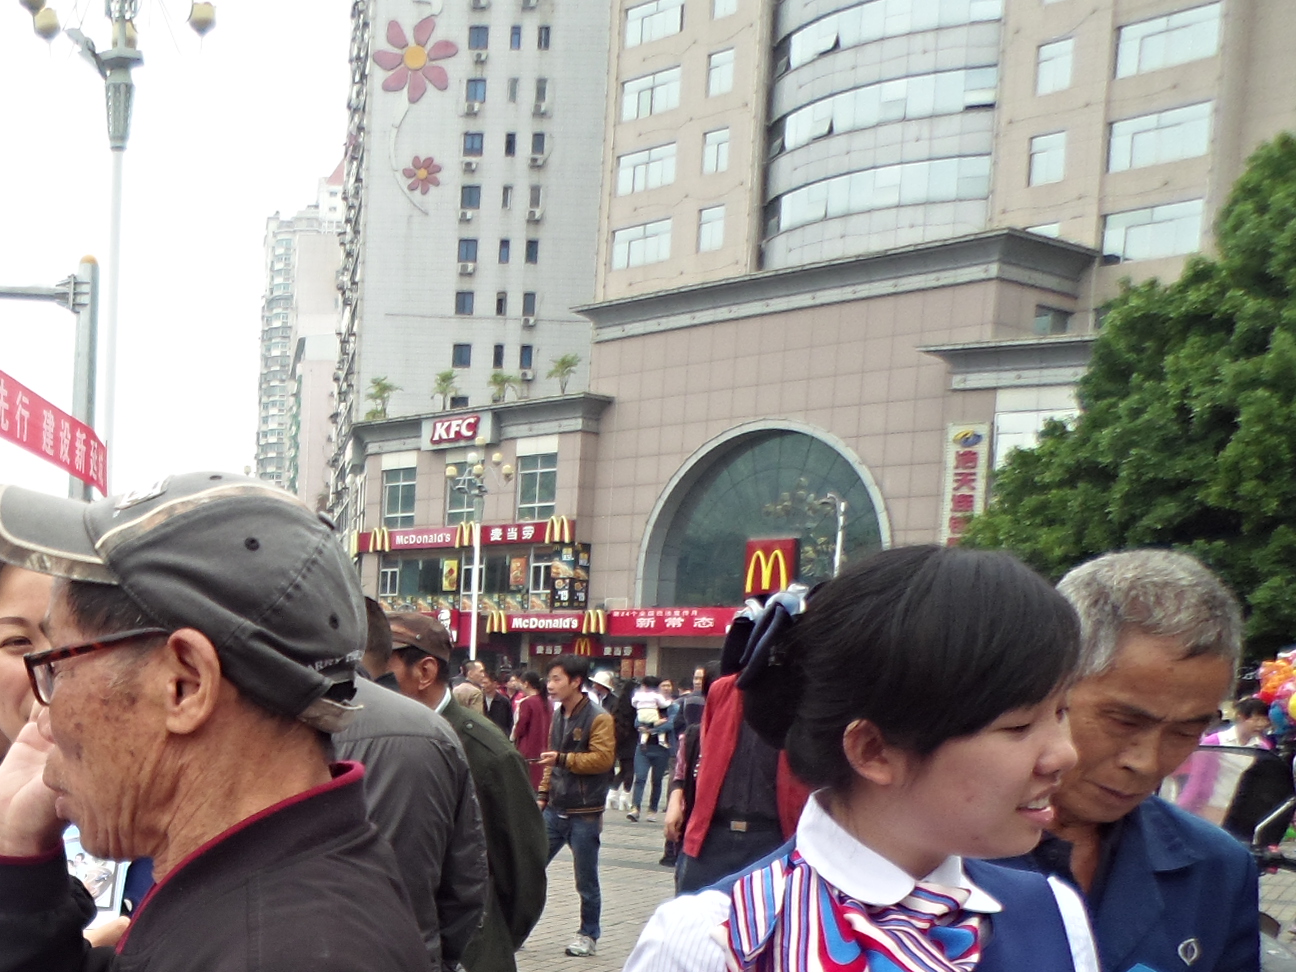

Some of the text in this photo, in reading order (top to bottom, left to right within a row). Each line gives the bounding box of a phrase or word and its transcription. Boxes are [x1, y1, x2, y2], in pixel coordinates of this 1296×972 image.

[432, 417, 477, 441] KFC
[395, 532, 452, 545] McDonald's
[489, 525, 535, 541] 麦当劳
[511, 617, 579, 630] McDonald's
[635, 616, 715, 629] 新常态
